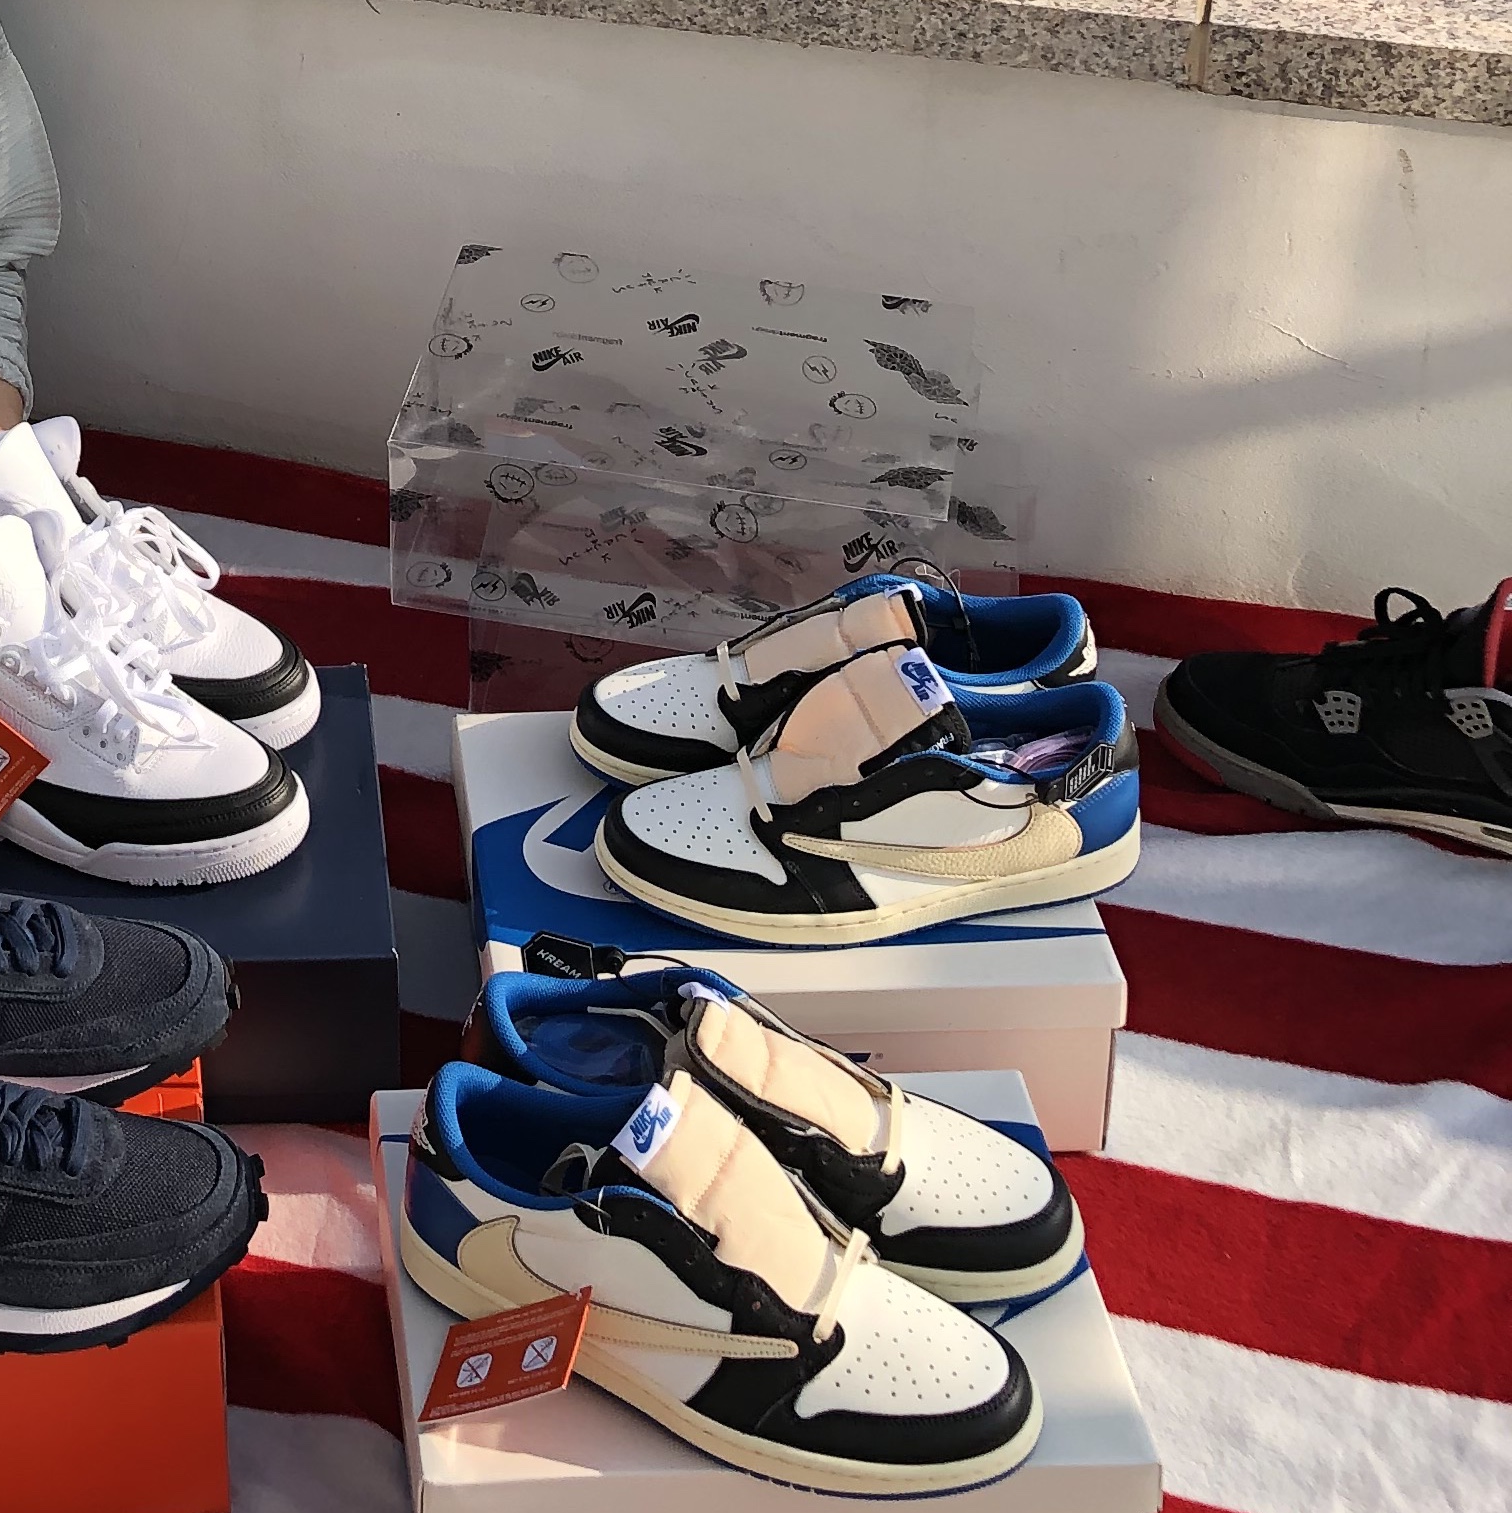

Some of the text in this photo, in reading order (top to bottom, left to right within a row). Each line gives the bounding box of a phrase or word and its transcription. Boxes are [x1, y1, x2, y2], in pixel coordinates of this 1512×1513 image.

[533, 346, 563, 364] NIKE
[562, 351, 585, 367] AIR
[841, 531, 874, 561] NIKE
[875, 539, 899, 563] AIR
[537, 948, 582, 979] KREAM
[629, 1103, 656, 1140] NIKE
[658, 1107, 674, 1130] AIR
